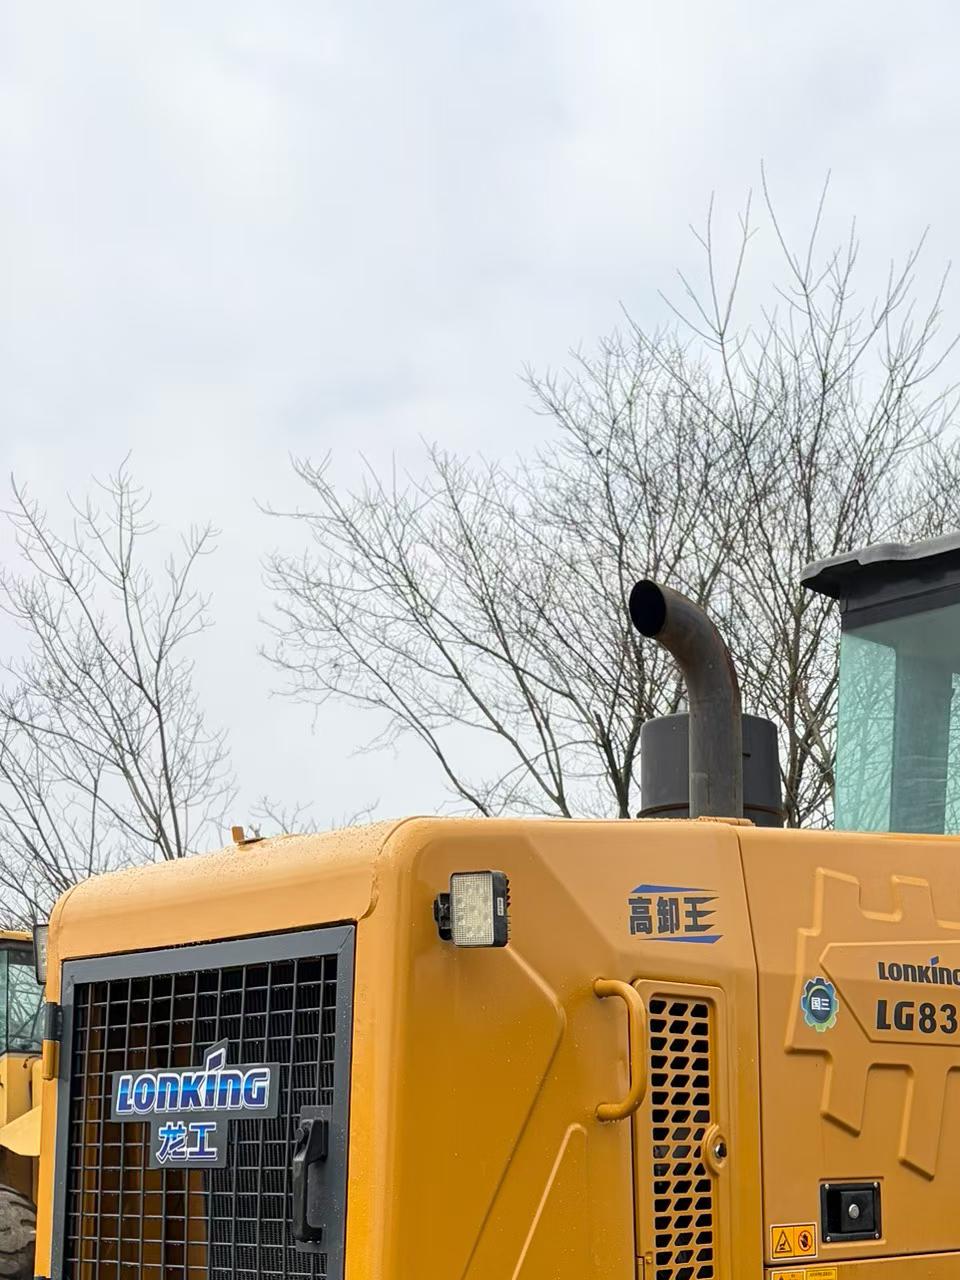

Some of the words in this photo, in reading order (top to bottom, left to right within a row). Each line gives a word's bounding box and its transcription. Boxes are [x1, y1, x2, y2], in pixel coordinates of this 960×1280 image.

[628, 896, 720, 935] 高卸王
[811, 996, 830, 1011] 国三
[156, 1121, 218, 1164] 龙工
